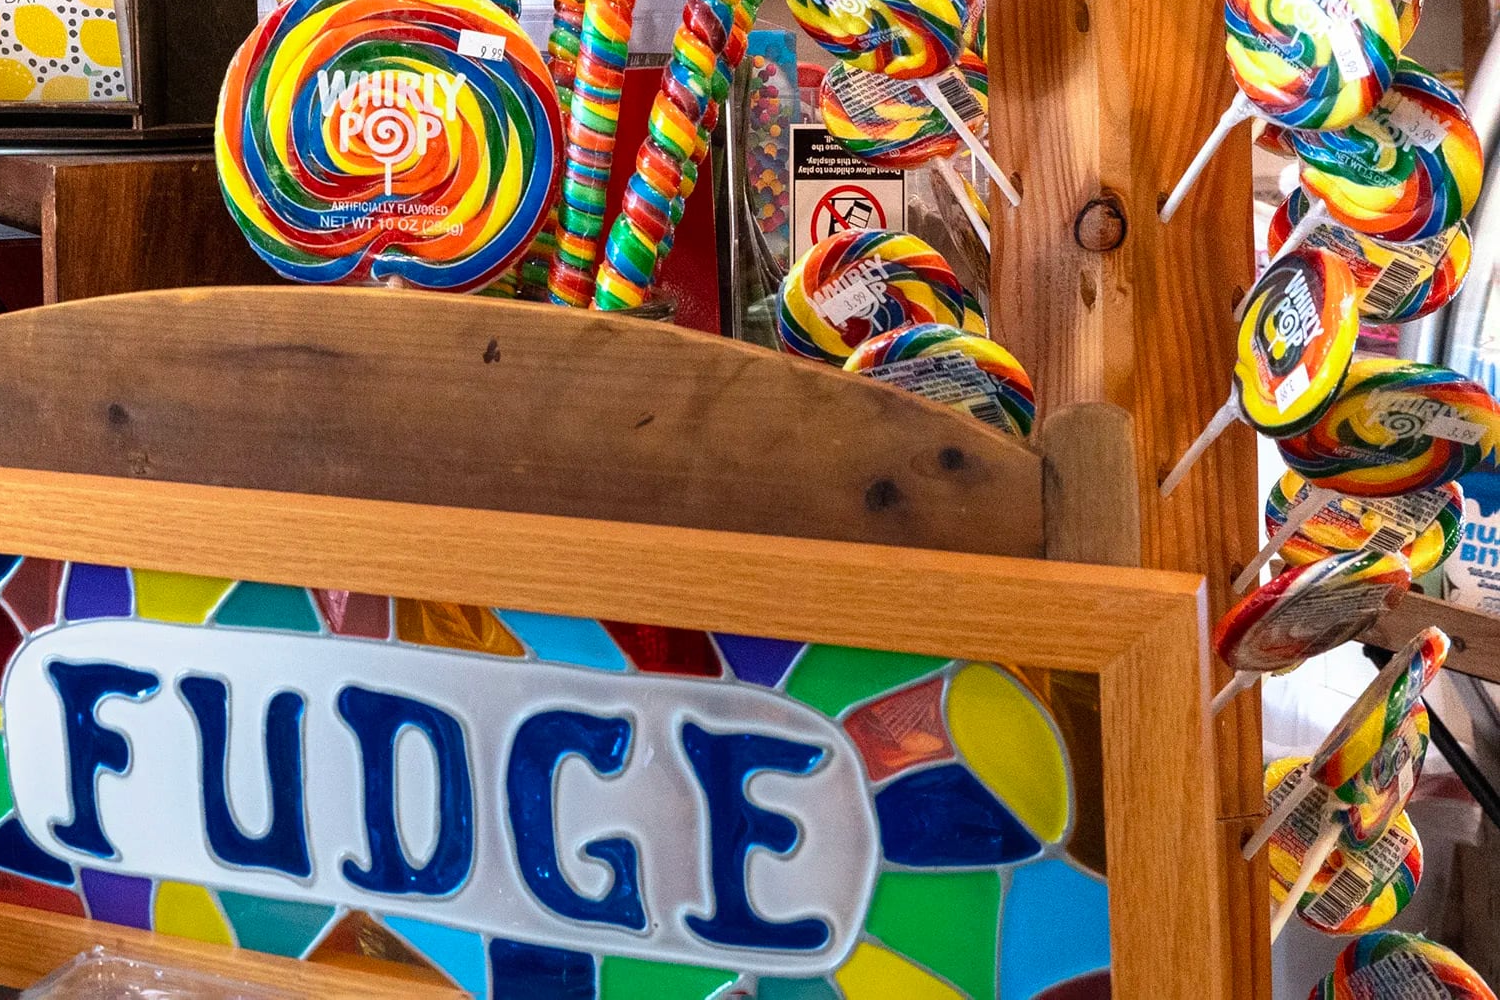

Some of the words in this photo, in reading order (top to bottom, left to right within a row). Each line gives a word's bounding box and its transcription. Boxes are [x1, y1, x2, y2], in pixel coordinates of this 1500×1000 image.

[317, 69, 467, 121] WHIRLY
[339, 107, 443, 172] POP
[811, 144, 824, 152] the
[798, 165, 814, 175] play
[806, 156, 835, 165] display.
[823, 166, 855, 175] children
[331, 201, 394, 215] ARTIFICIALLY
[397, 203, 448, 216] FLAVORED
[319, 215, 348, 228] NET
[351, 216, 374, 229] WT
[377, 217, 394, 230] 10
[397, 218, 418, 231] OZ
[845, 290, 869, 312] 3.99
[1284, 269, 1324, 347] WHIRLY
[1274, 298, 1311, 350] POP
[45, 655, 836, 957] FUDGE
